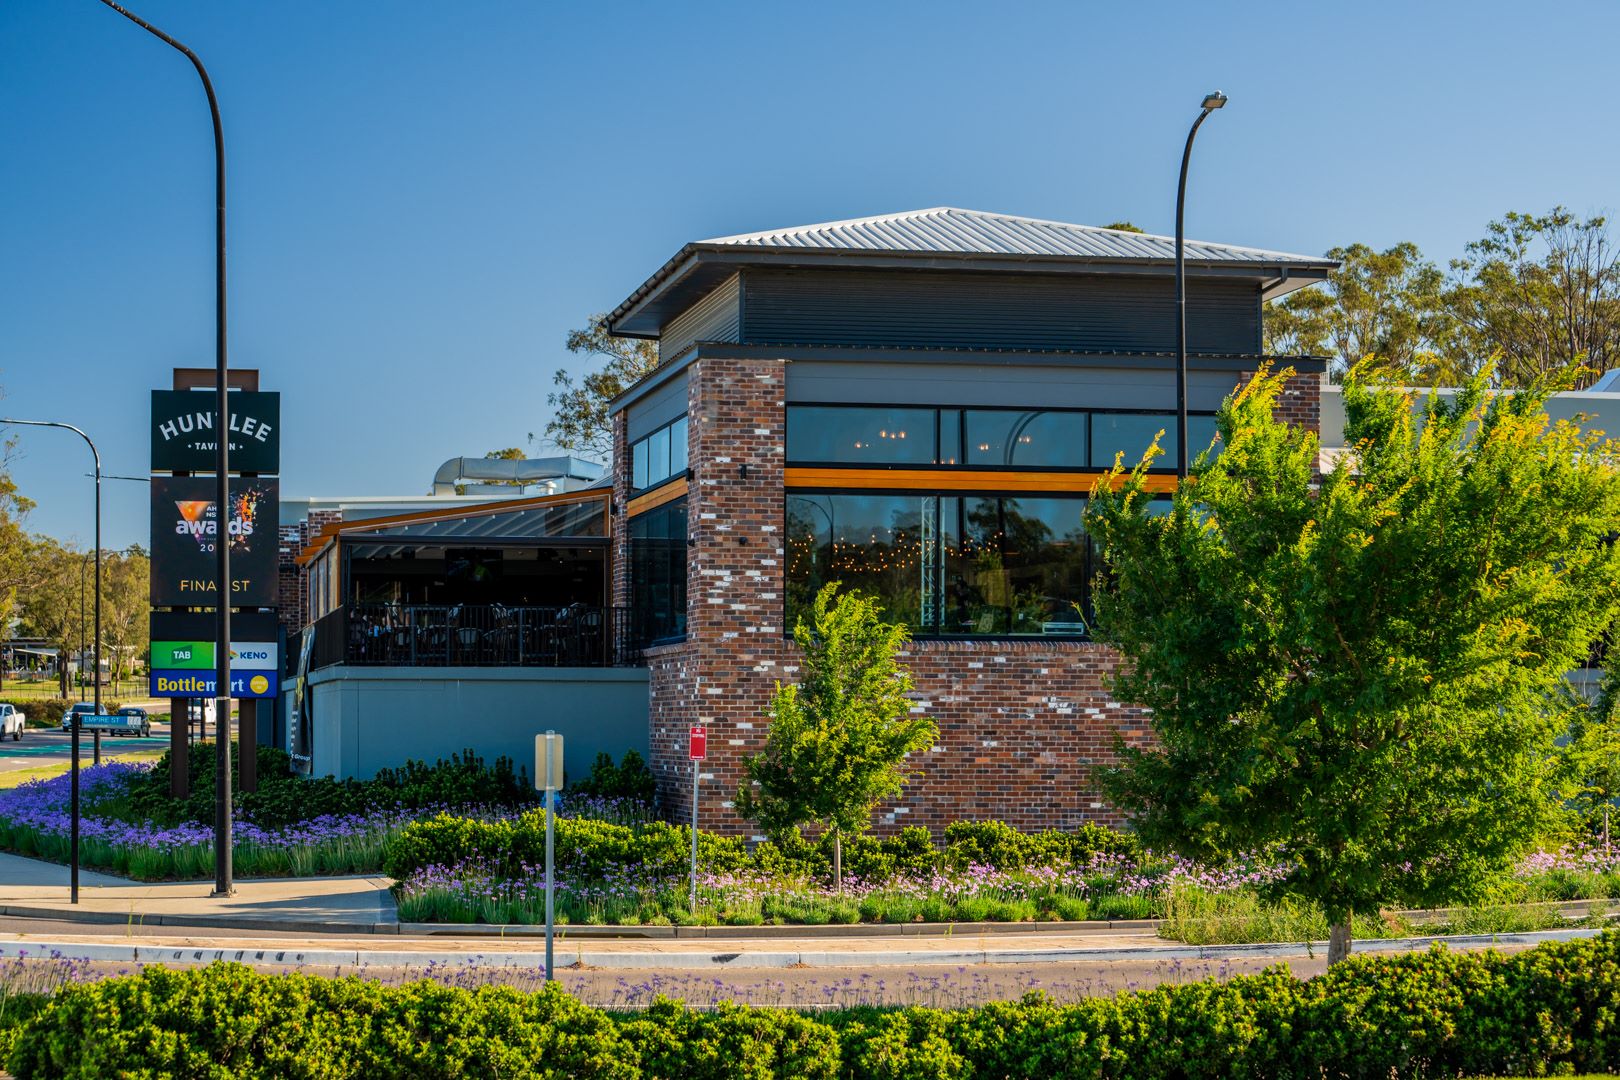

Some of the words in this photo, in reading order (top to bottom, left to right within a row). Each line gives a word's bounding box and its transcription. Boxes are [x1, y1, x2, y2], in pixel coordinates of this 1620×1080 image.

[159, 411, 272, 442] HUNLEE
[195, 442, 236, 450] TAVN
[175, 516, 253, 535] awads
[180, 580, 250, 592] FINAST
[173, 650, 191, 660] TAB
[240, 651, 268, 660] KENO
[157, 676, 244, 692] Bottlemrt
